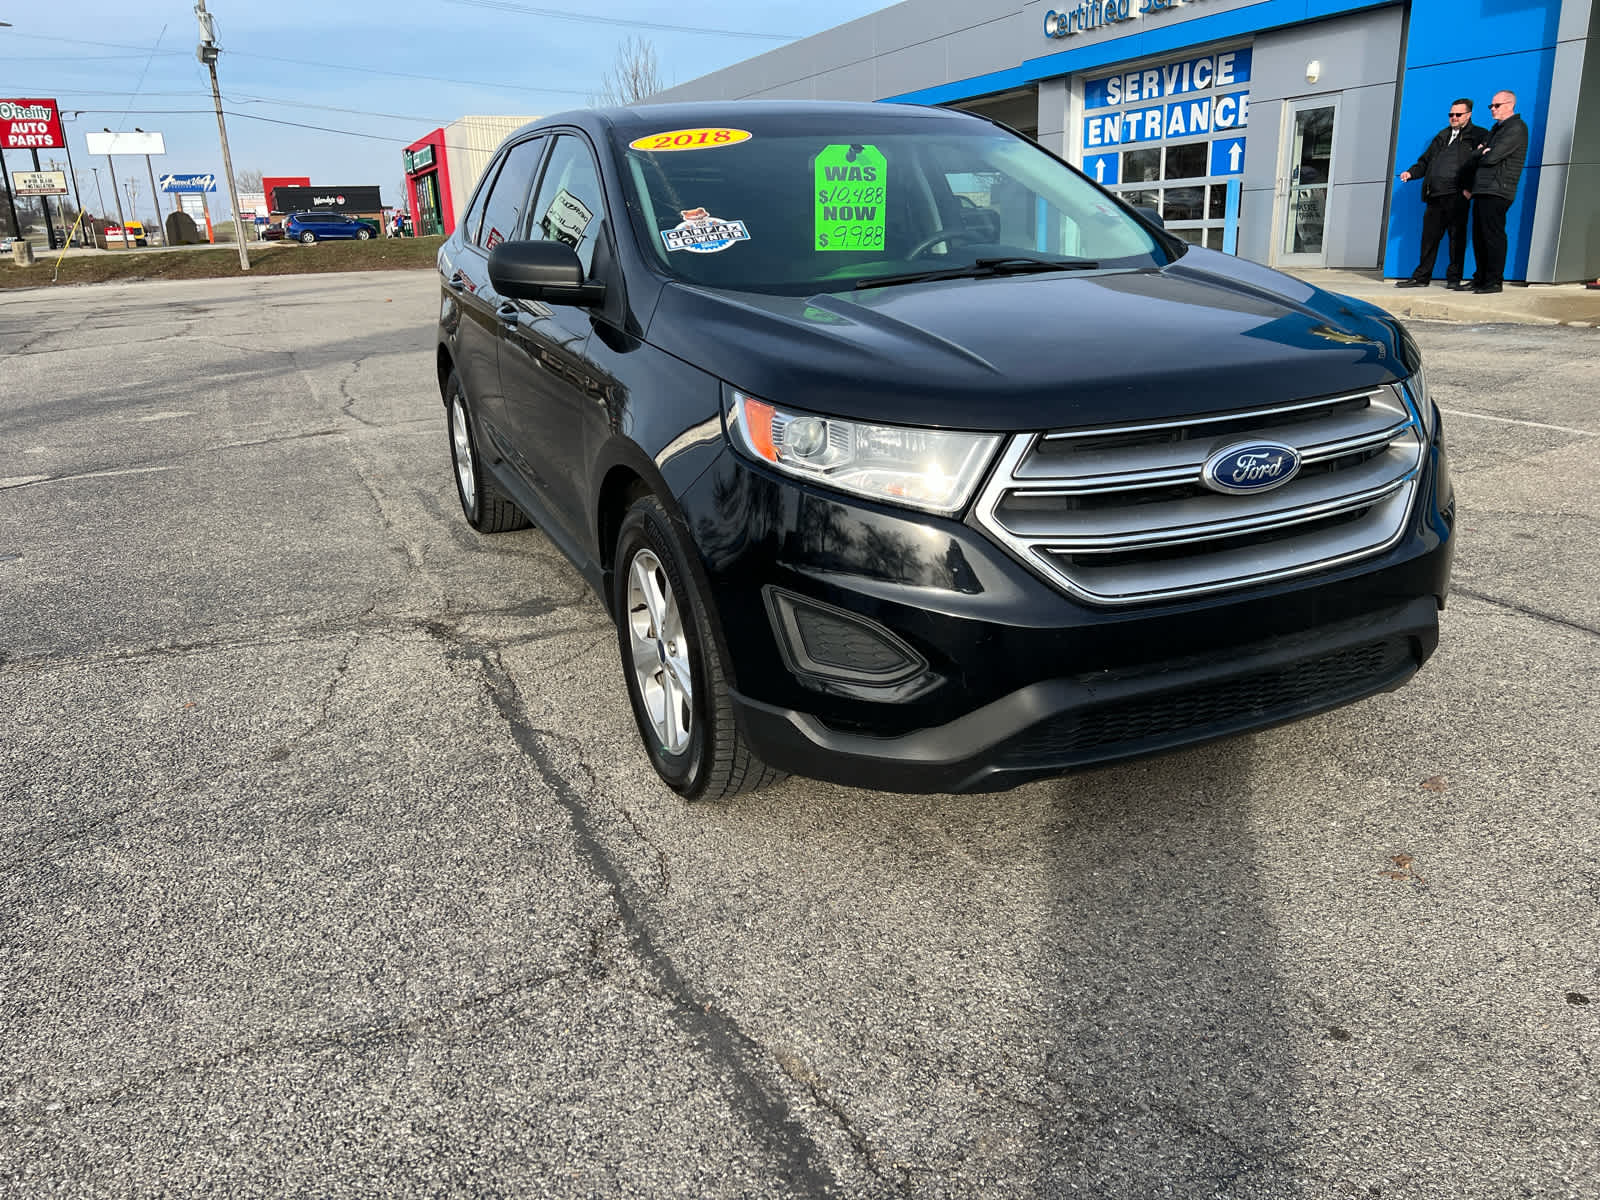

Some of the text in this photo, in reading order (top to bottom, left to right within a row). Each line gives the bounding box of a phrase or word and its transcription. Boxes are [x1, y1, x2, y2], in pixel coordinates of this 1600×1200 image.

[1106, 53, 1235, 104] SERVICE
[0, 102, 51, 121] O'Reilly
[1088, 94, 1249, 145] ENTRANCE
[11, 122, 48, 134] AUTO
[8, 134, 54, 146] PARTS
[653, 130, 731, 149] 2018
[824, 166, 877, 182] WAS
[819, 186, 884, 205] $10,488
[823, 206, 877, 221] NOW
[667, 225, 738, 240] CARFAX
[682, 231, 745, 246] OWNER
[1232, 452, 1283, 483] Ford
